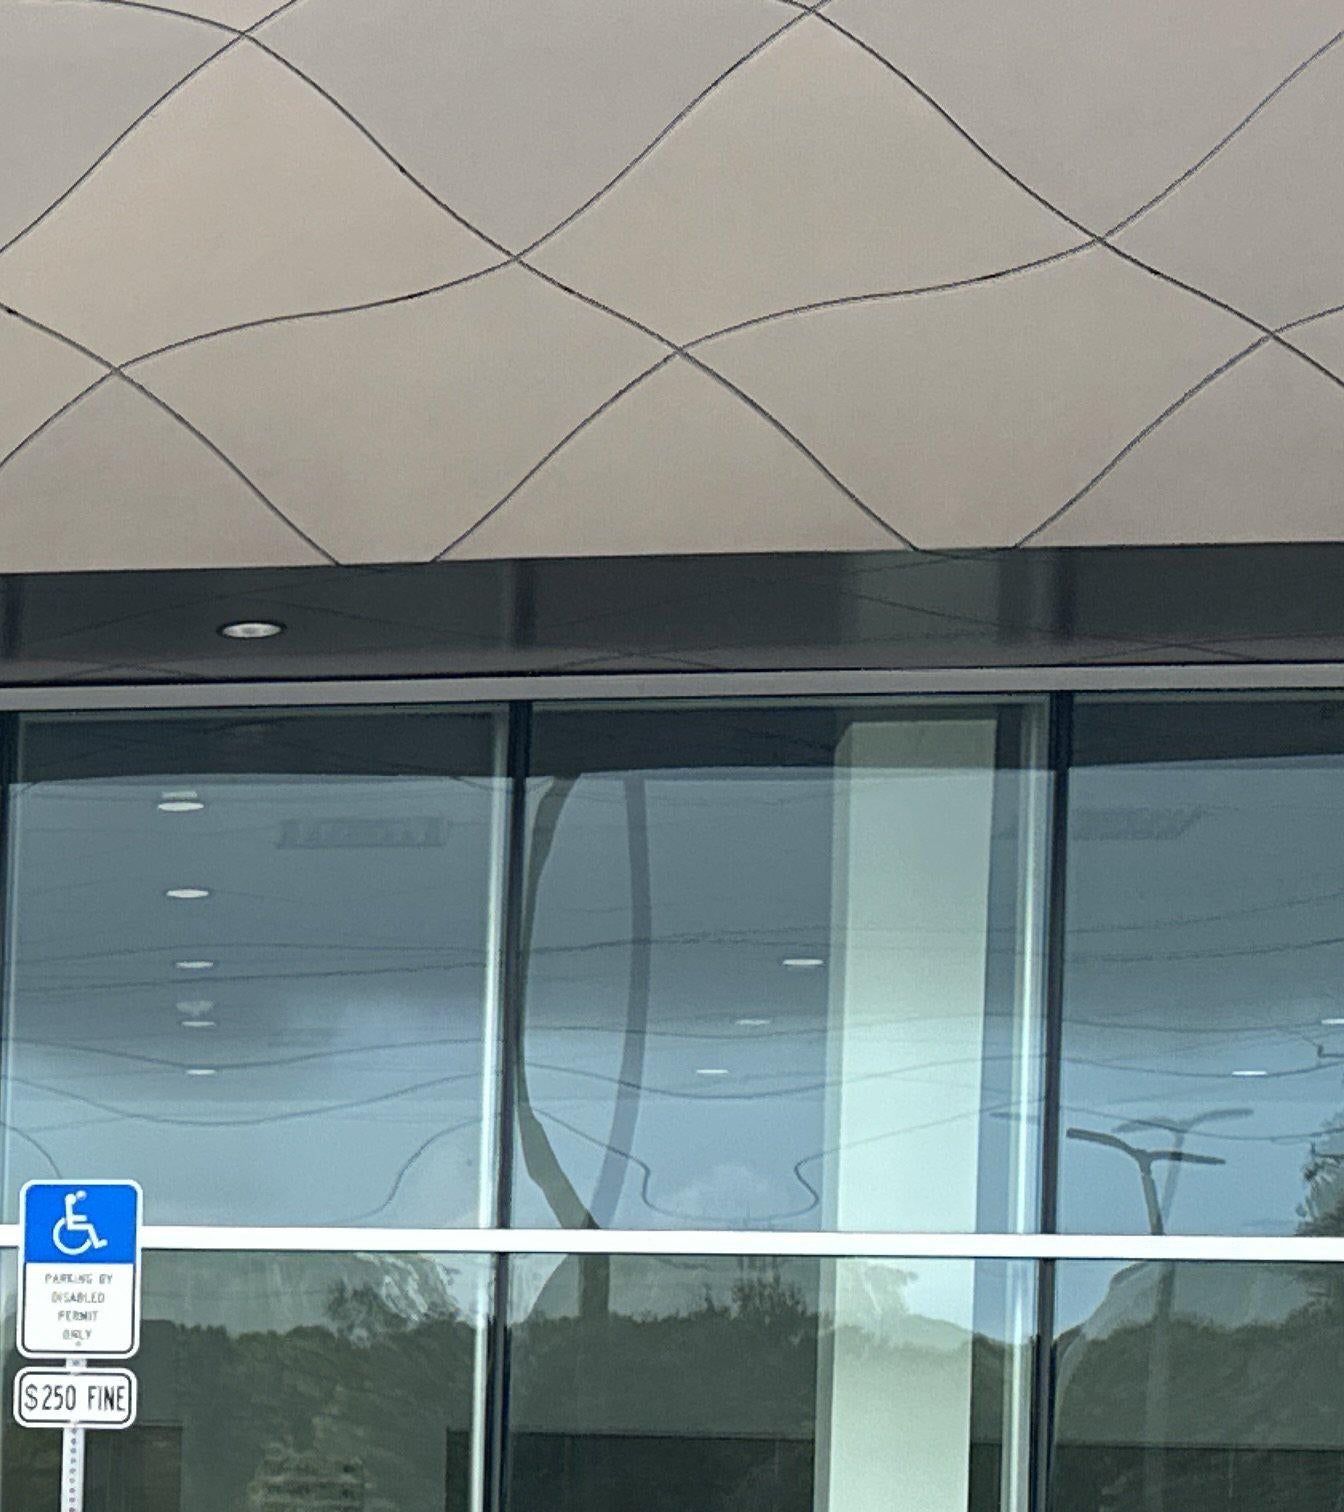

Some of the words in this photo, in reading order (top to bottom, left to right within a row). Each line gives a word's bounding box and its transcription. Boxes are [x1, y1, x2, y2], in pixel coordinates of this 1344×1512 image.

[45, 1273, 93, 1286] PARKING
[98, 1273, 113, 1286] BY
[51, 1292, 106, 1304] DISABLED
[58, 1310, 99, 1322] PERMIT
[24, 1383, 77, 1412] $250
[87, 1384, 126, 1412] FINE
